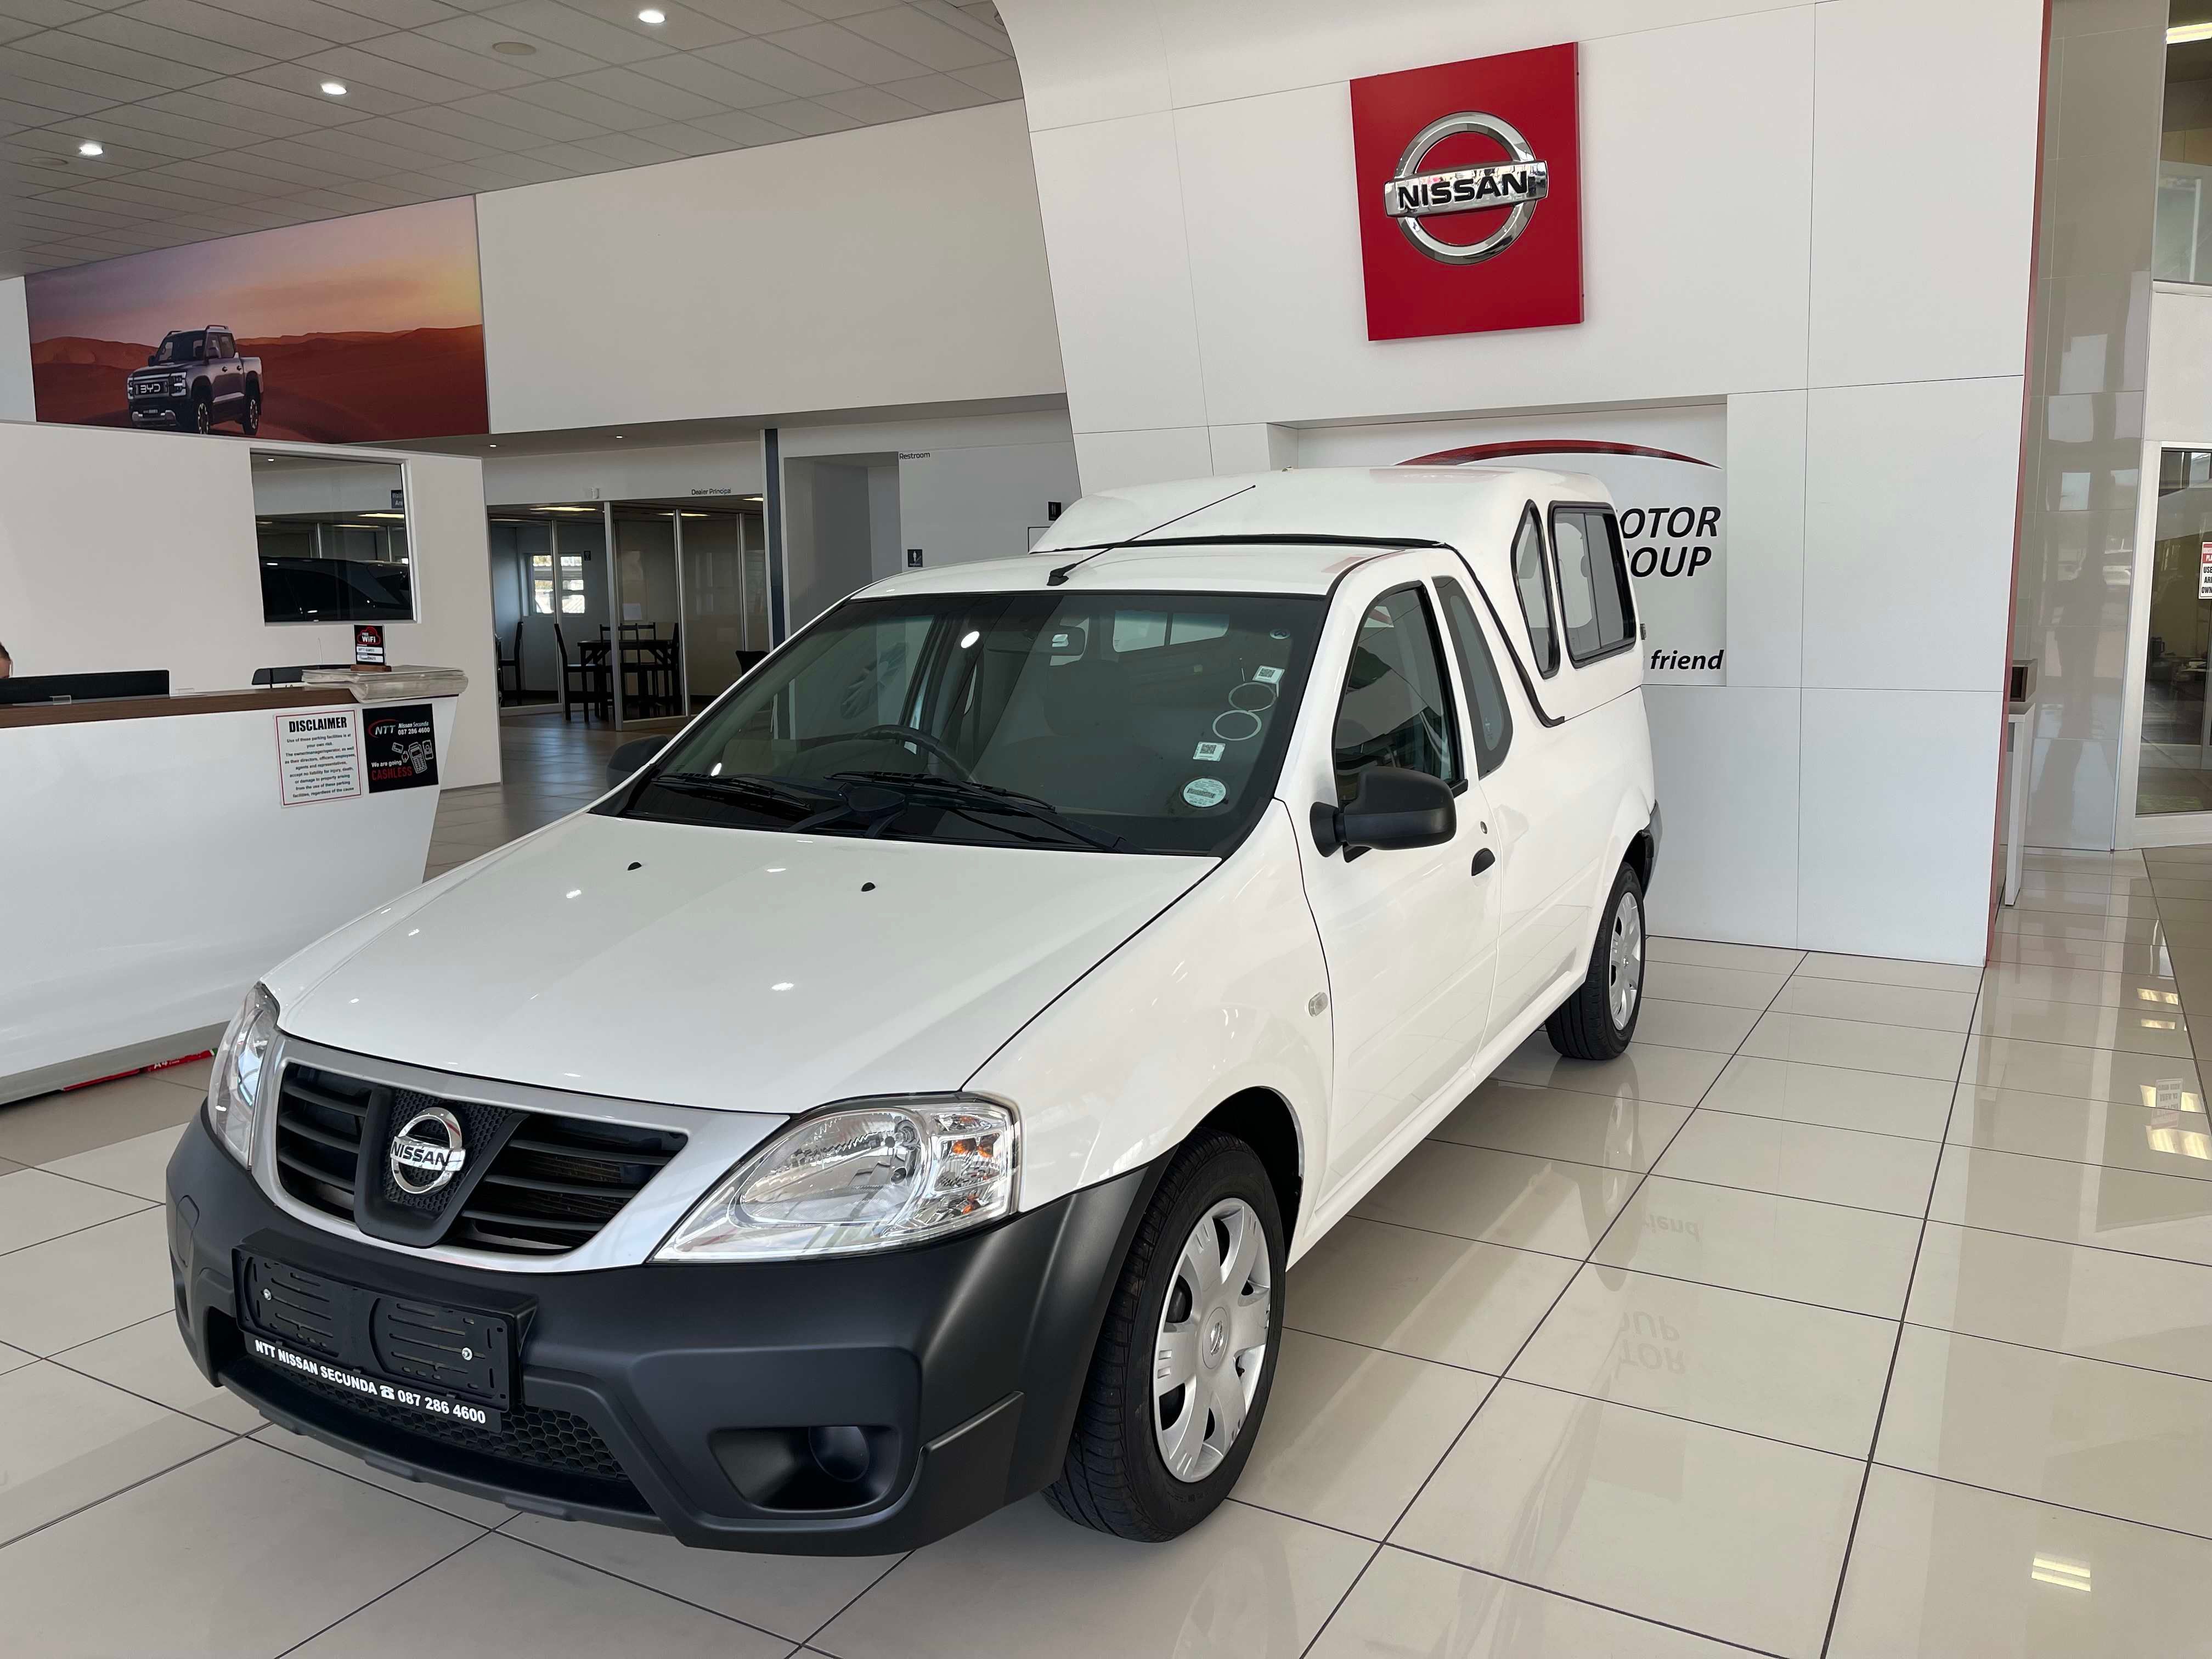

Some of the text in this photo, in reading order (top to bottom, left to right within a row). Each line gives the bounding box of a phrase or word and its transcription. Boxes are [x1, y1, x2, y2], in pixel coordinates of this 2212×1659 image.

[1398, 171, 1528, 209] NISSAN
[140, 383, 161, 393] BYD
[709, 487, 732, 495] Principal
[1617, 506, 1721, 539] OTOR
[1626, 546, 1712, 577] OUP
[1650, 649, 1725, 670] friend
[289, 716, 347, 732] DISCLAIMER
[375, 725, 396, 735] NTT
[371, 766, 413, 780] CASHLESS
[391, 1141, 453, 1166] NISSAN
[254, 1339, 487, 1425] NTT NISSAN SECUNDA 087 286 4600
